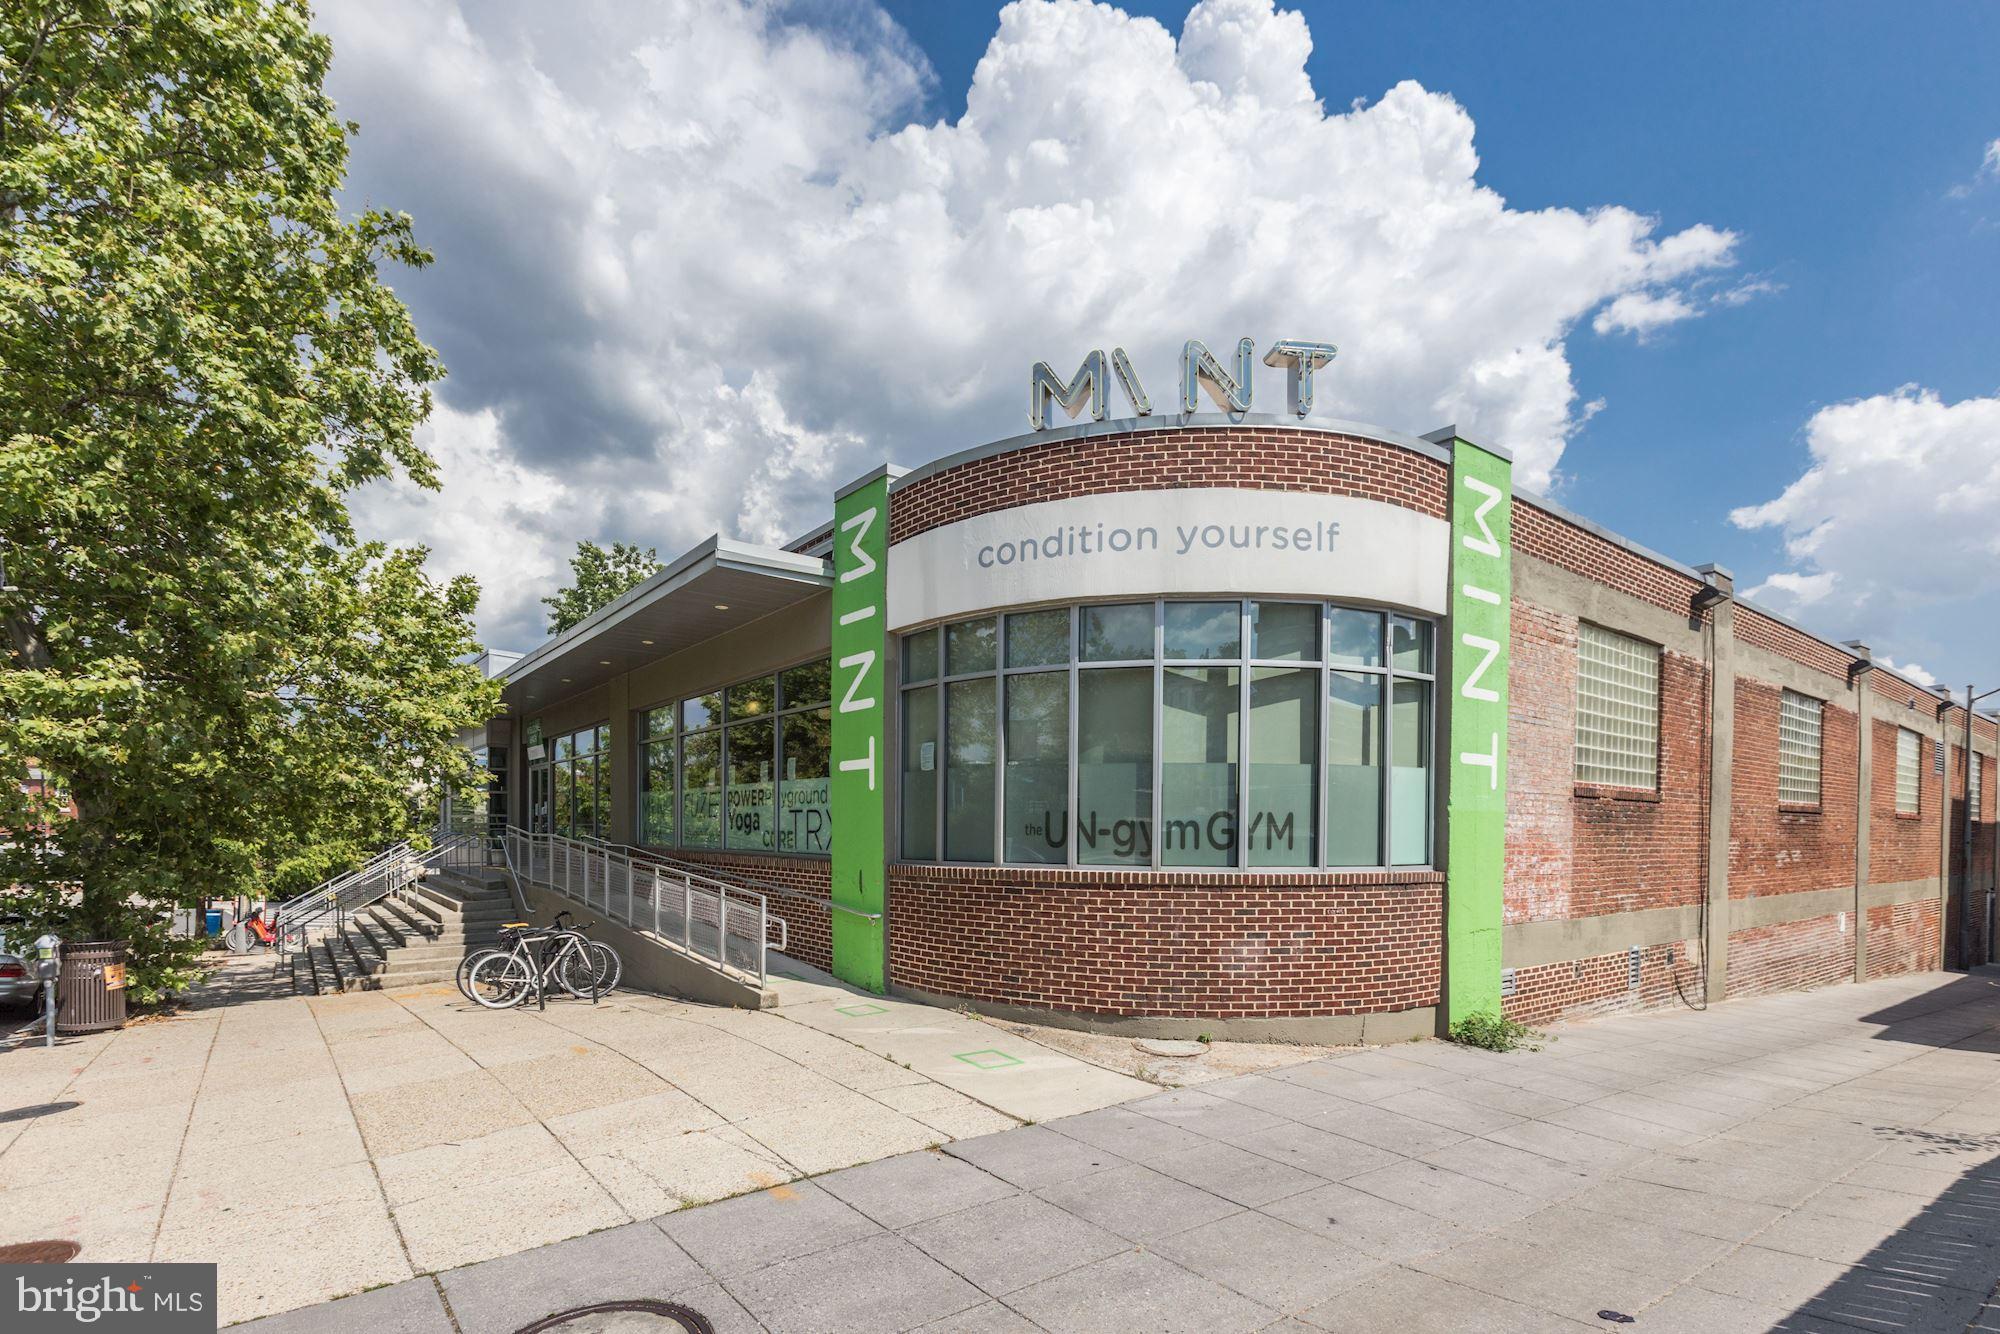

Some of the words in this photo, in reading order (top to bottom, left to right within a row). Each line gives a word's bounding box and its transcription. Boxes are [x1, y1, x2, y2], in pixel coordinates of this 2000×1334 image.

[1030, 337, 1338, 431] MINT
[978, 523, 1157, 568] condition
[1176, 521, 1341, 555] yourself
[839, 507, 877, 791] MINT
[1460, 475, 1502, 791] MINT
[1024, 823, 1042, 837] the
